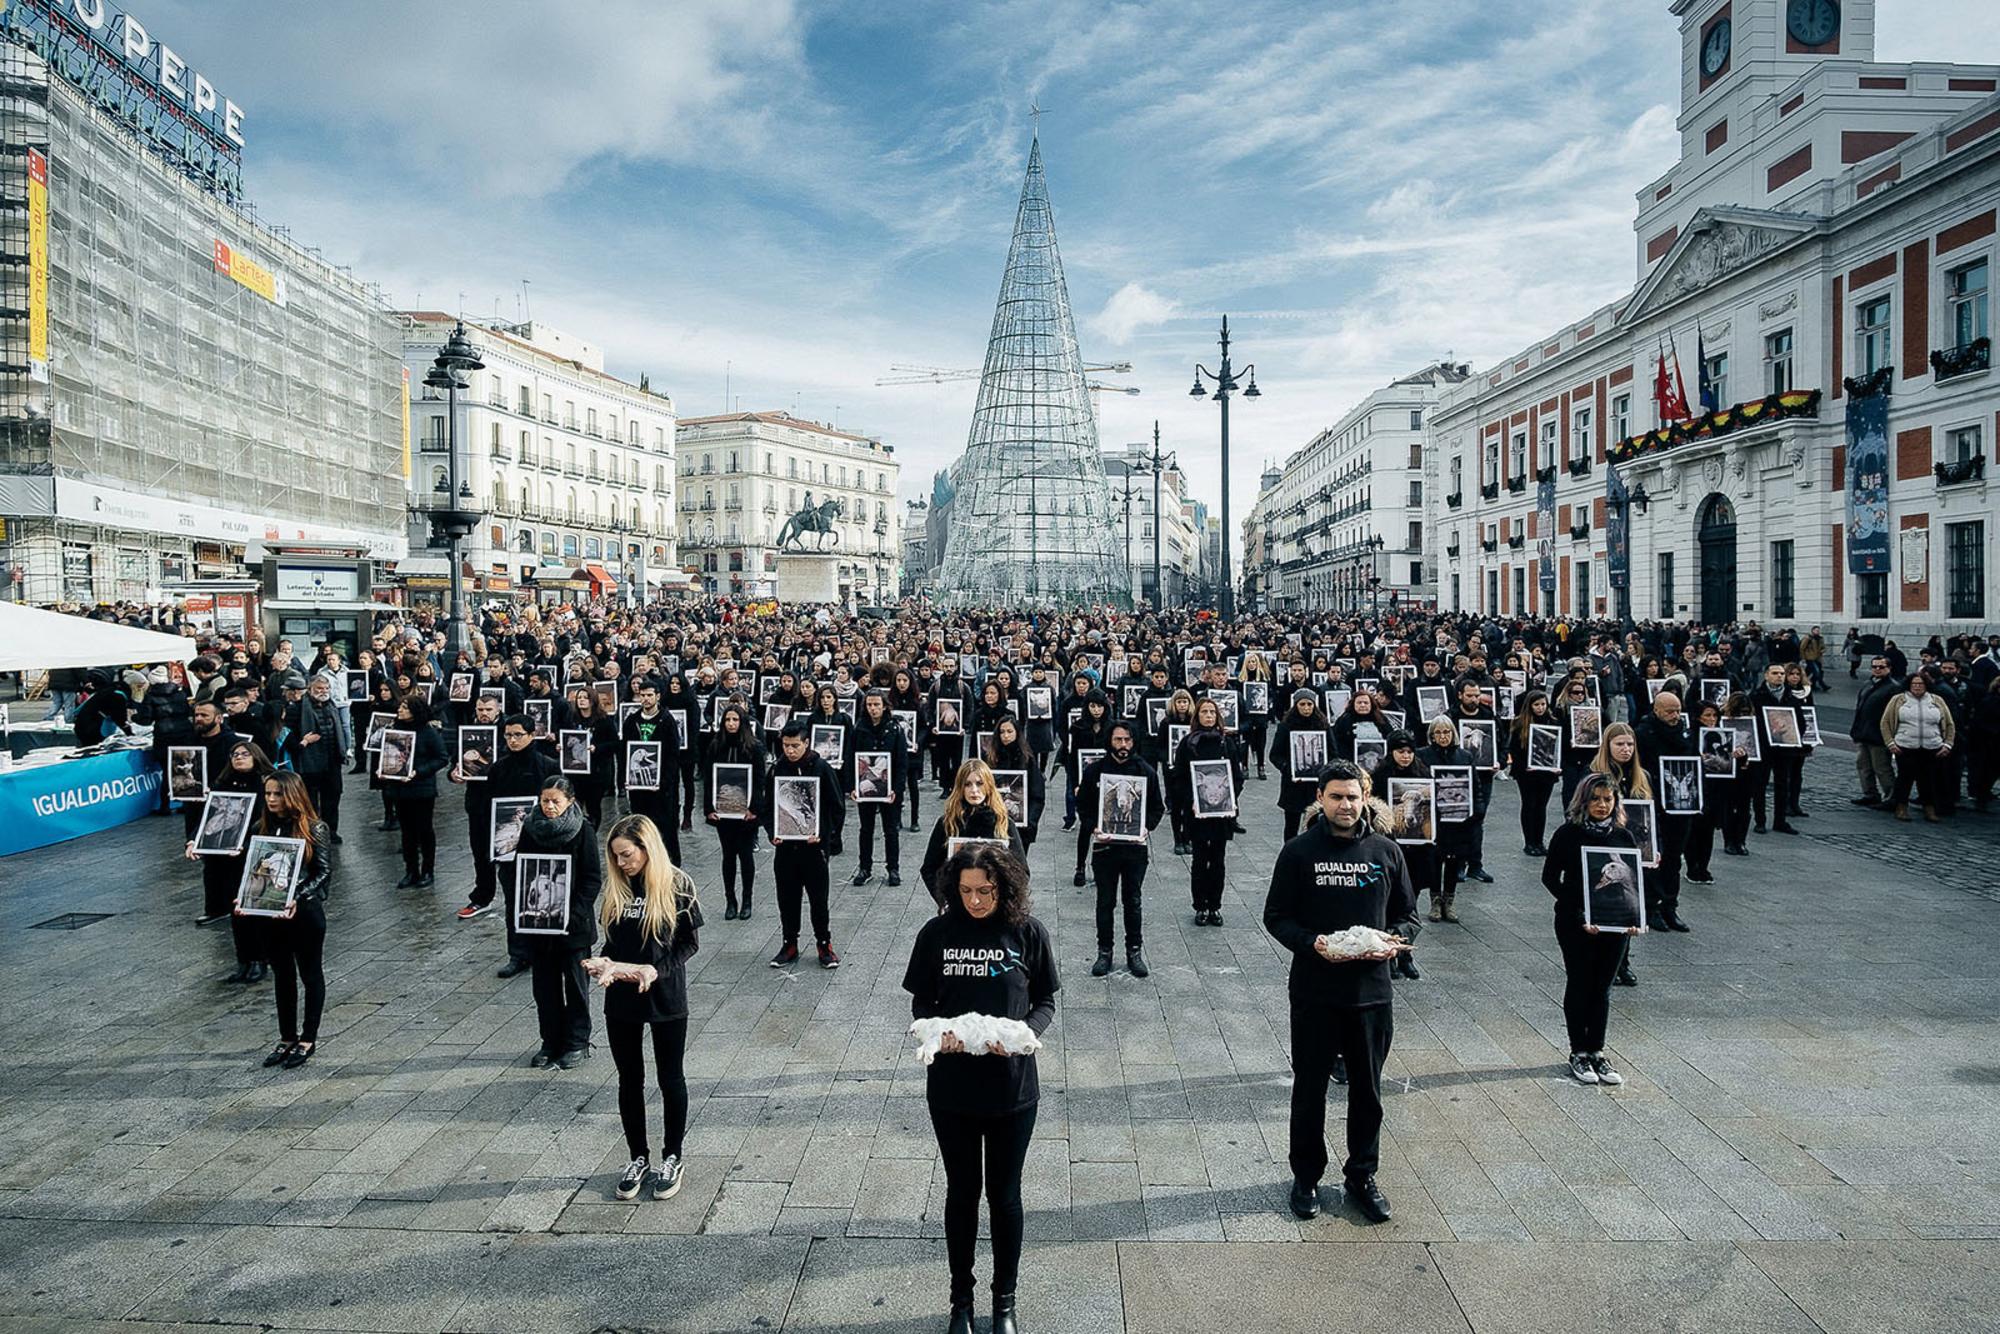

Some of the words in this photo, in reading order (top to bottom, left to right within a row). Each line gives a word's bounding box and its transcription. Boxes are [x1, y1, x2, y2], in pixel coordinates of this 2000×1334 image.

[124, 13, 245, 147] PEPE
[1314, 862, 1369, 873] IGUALDAD
[1315, 872, 1357, 887] animal
[943, 948, 1005, 961] IGUALDAD
[942, 959, 988, 977] animal
